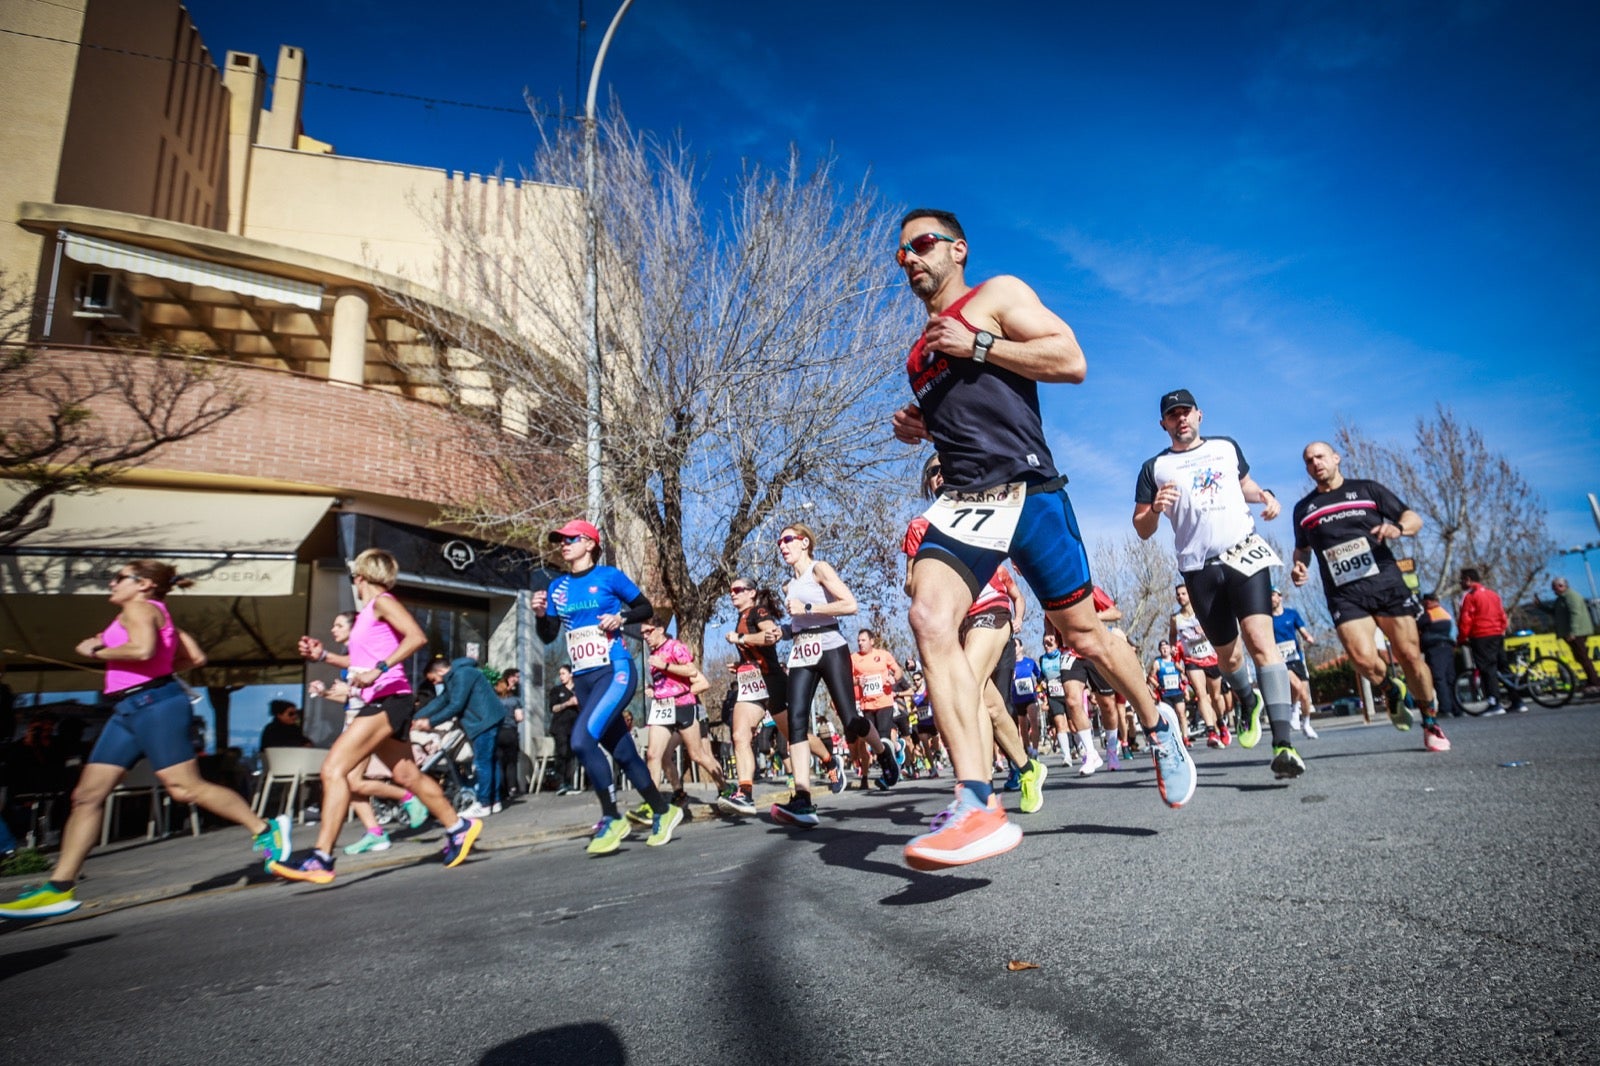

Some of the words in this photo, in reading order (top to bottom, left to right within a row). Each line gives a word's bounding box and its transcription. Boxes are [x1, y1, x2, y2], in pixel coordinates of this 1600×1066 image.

[949, 507, 995, 532] 77
[1240, 545, 1271, 565] 109
[1332, 553, 1372, 576] 3096
[570, 642, 607, 661] 2005
[792, 641, 821, 660] 2160
[741, 680, 766, 695] 2194
[863, 681, 881, 692] 709
[655, 707, 673, 719] 752
